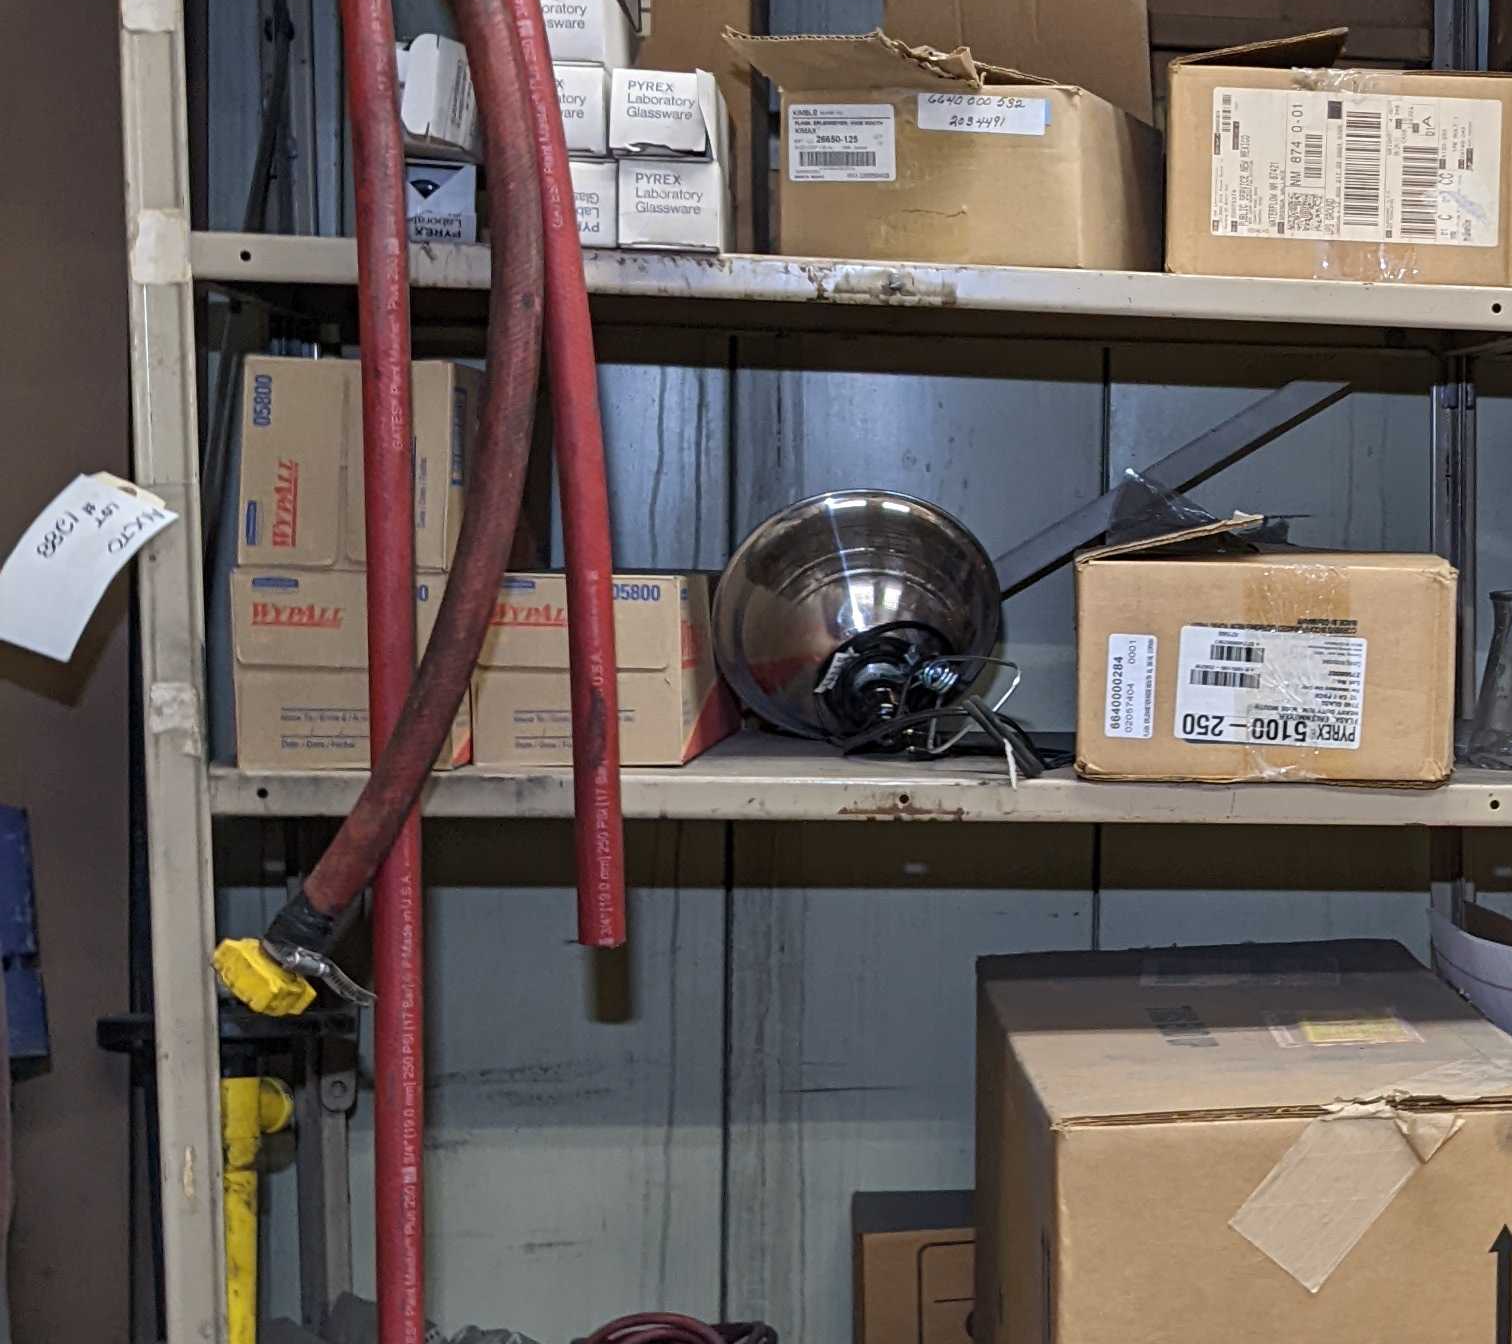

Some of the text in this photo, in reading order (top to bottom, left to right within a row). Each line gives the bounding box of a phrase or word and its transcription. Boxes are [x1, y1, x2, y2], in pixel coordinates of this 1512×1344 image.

[627, 80, 674, 93] PYREX
[627, 94, 696, 109] Laboratory
[928, 94, 992, 106] 6640 000
[627, 107, 693, 120] Glassware
[1240, 135, 1250, 158] MEXICO
[1240, 160, 1250, 173] NEW
[1290, 141, 1302, 186] NM 874
[635, 172, 681, 185] PYREX
[1239, 175, 1250, 201] SERVICE
[635, 187, 703, 202] Laboratory
[635, 201, 702, 215] Glassware
[1326, 199, 1335, 220] GROUND
[414, 226, 462, 239] PYREX
[253, 374, 273, 428] 05800
[490, 602, 567, 625] WYPAL
[1110, 656, 1123, 730] 6640000284
[1183, 714, 1356, 743] PYREX 5100 250
[403, 1034, 414, 1053] PSI
[404, 1057, 415, 1078] 250
[403, 1186, 415, 1207] 250
